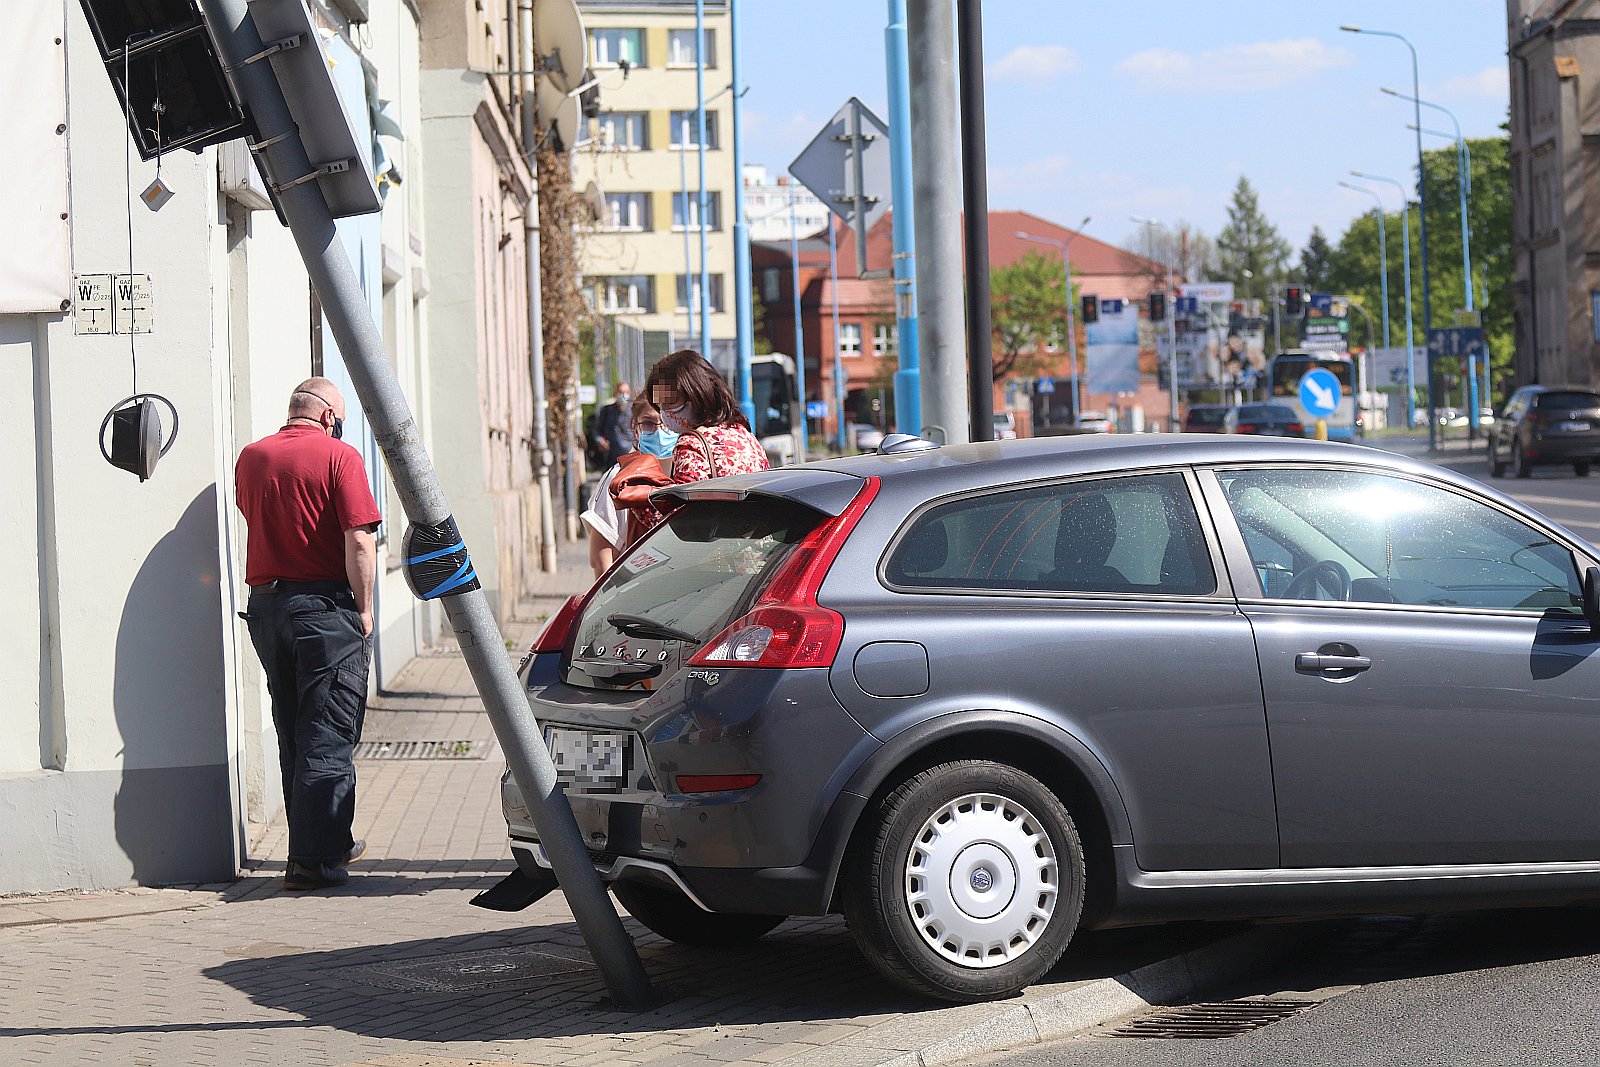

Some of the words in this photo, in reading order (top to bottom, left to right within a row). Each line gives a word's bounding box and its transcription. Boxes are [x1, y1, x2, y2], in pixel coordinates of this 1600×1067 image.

[78, 285, 93, 301] W
[118, 285, 133, 301] W
[578, 645, 669, 662] VOLVO
